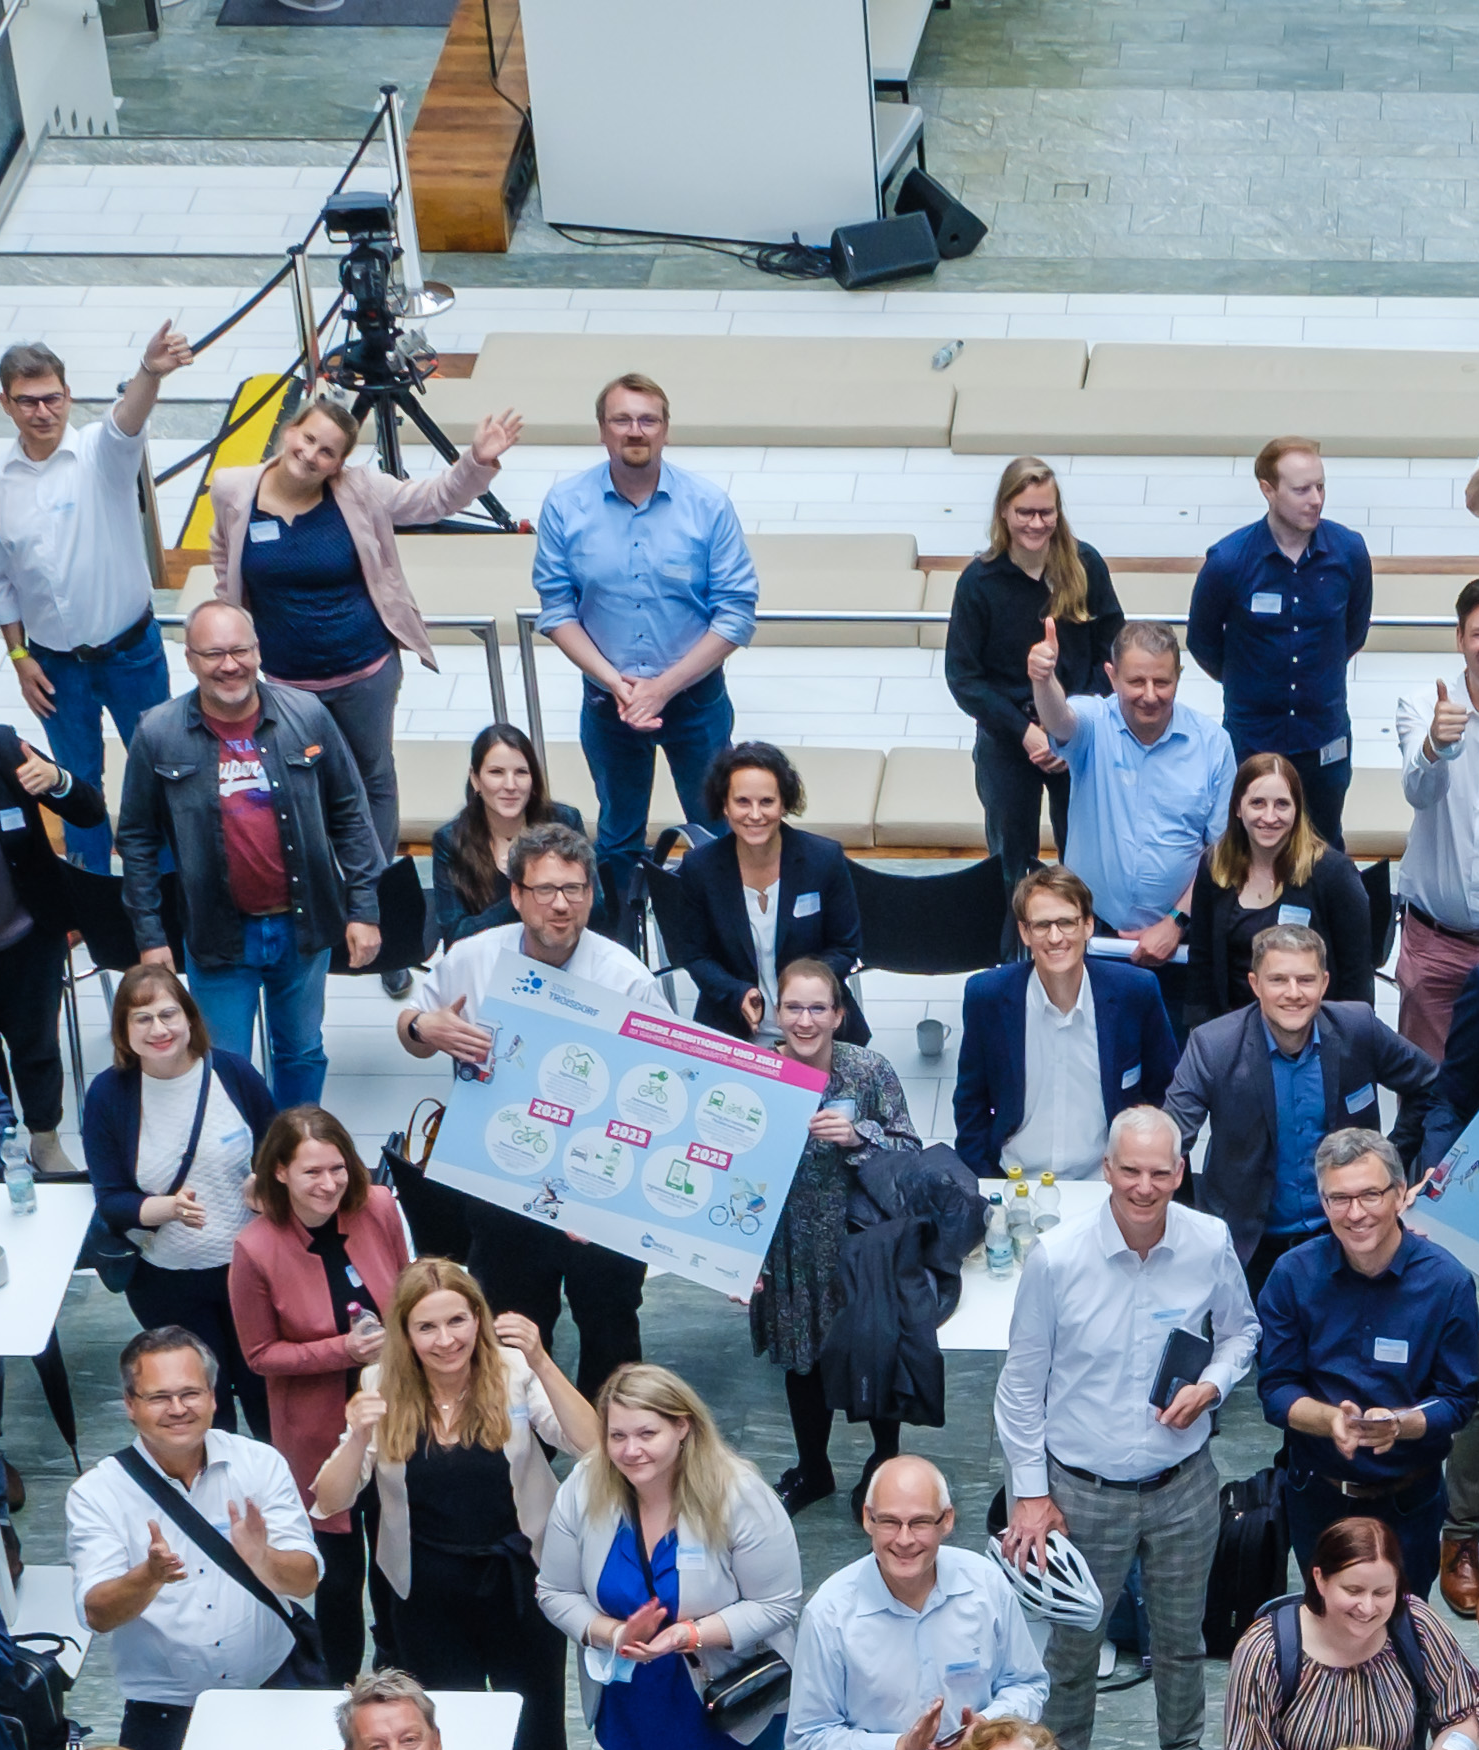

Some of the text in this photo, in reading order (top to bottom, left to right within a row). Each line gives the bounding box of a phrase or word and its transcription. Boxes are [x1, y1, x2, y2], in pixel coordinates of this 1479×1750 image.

[226, 738, 255, 753] TEA
[547, 992, 601, 1017] TROISDORF
[733, 1047, 755, 1061] UND
[755, 1054, 783, 1069] ZIELE
[532, 1102, 571, 1122] 2022
[611, 1123, 648, 1144] 2023
[691, 1146, 728, 1167] 2025
